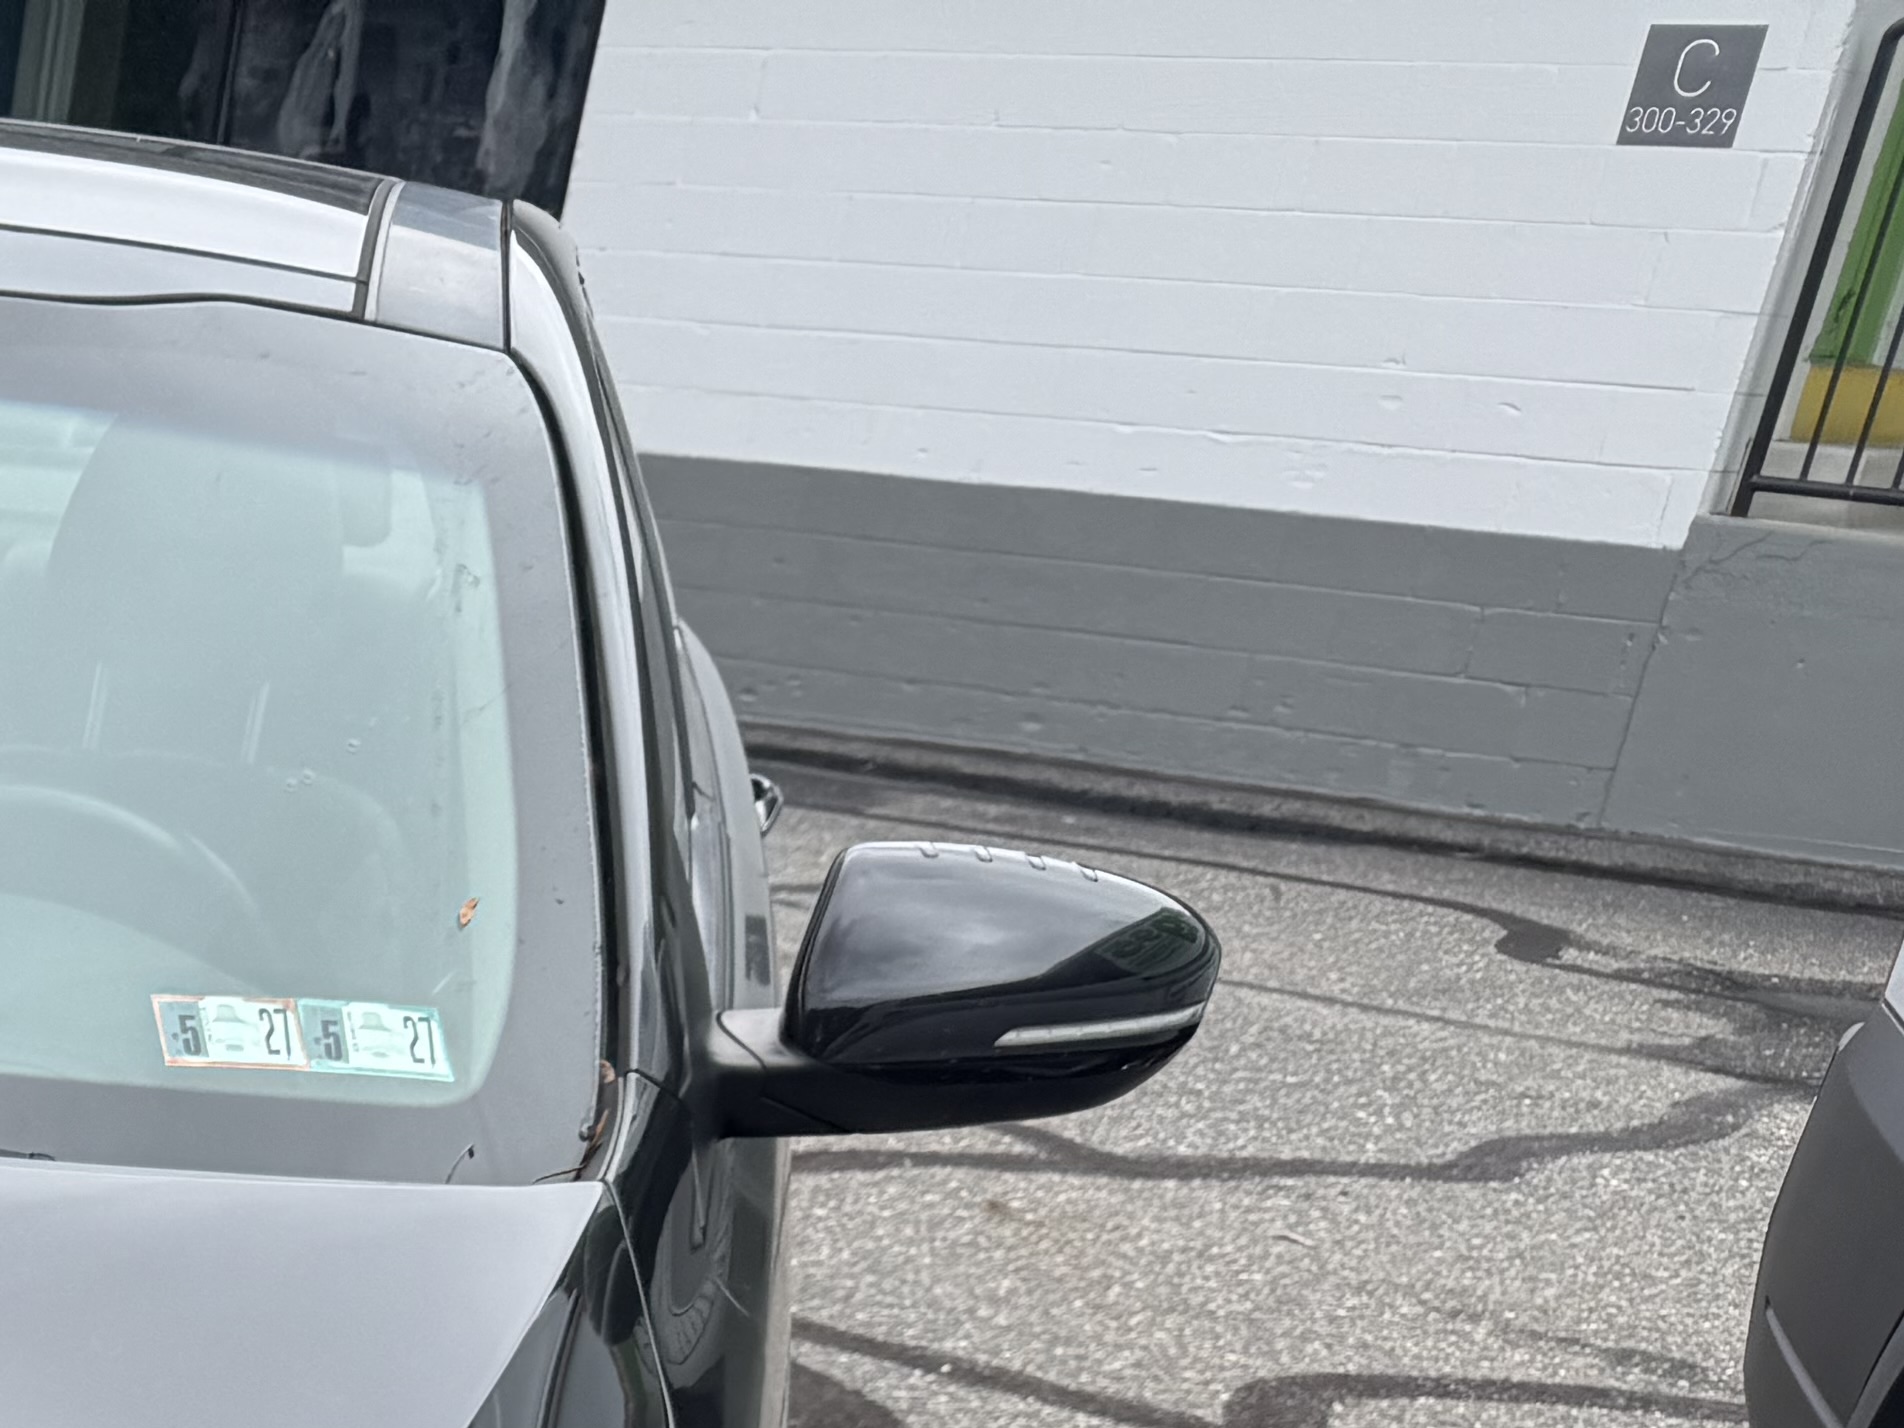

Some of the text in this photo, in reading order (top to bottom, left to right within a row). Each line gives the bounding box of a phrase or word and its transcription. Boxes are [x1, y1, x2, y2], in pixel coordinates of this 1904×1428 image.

[1673, 38, 1720, 98] C
[1625, 106, 1738, 135] 300-329
[178, 1014, 202, 1056] 5
[258, 1008, 292, 1060] 27
[320, 1019, 343, 1061] 5
[403, 1015, 436, 1068] 27
